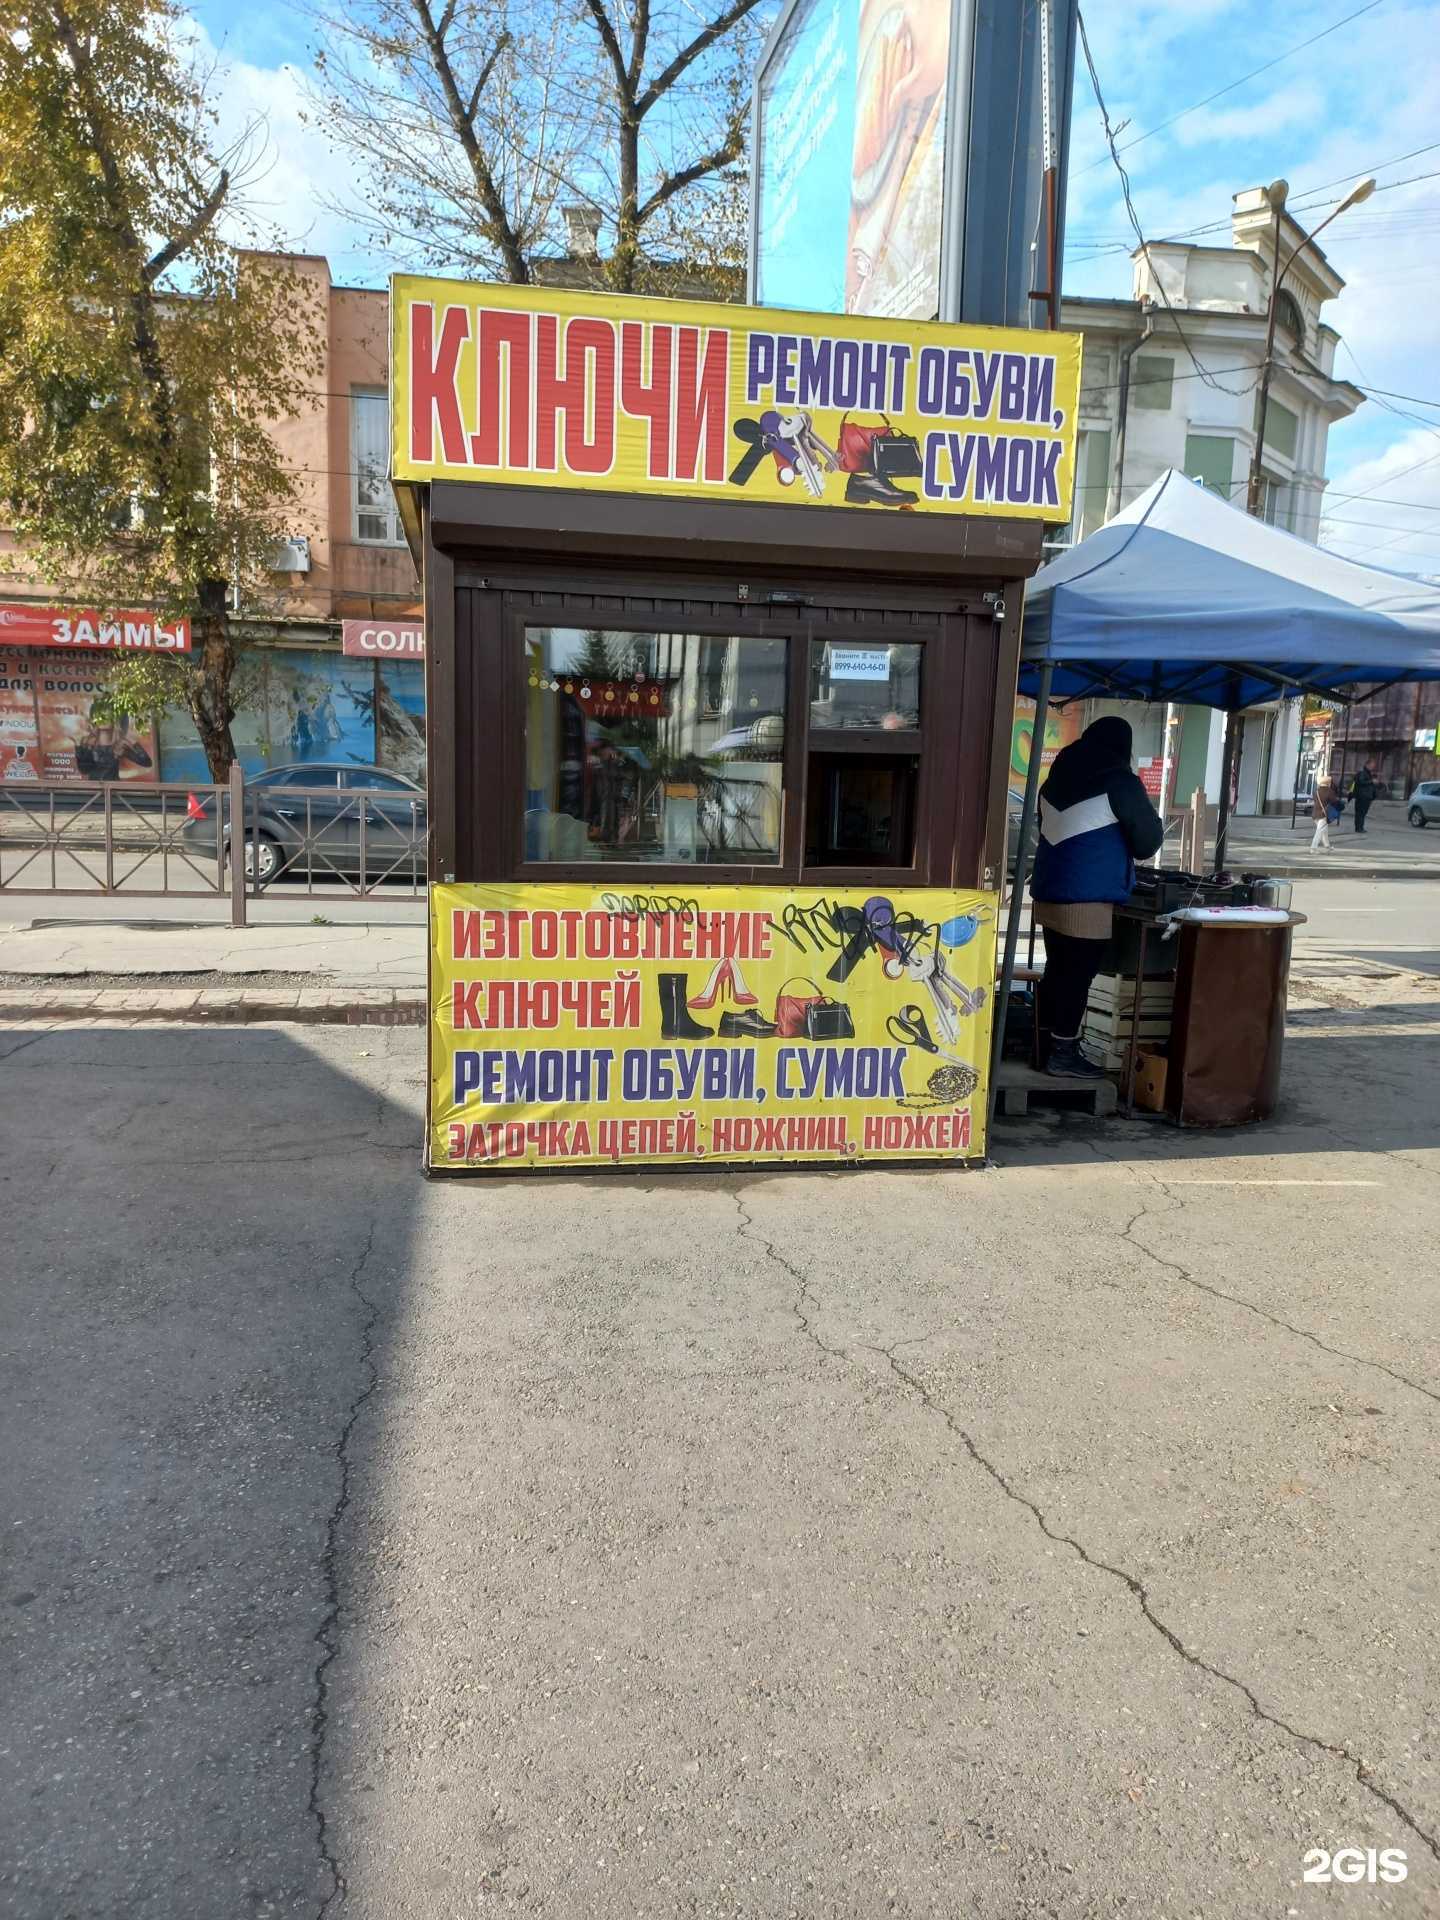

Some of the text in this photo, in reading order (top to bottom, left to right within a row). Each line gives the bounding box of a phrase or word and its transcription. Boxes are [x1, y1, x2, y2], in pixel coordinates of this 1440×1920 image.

[410, 303, 728, 483] КЛЮЧИ
[748, 333, 1063, 429] РЕМОНТ ОБУВИ,
[924, 431, 1062, 506] СУМОК
[52, 612, 185, 649] ЗАЙМЫ
[452, 910, 772, 960] ИЗГОТОВЛЕНИЕ
[452, 971, 640, 1030] КЛЮЧЕЙ
[454, 1047, 908, 1104] РЕМОНТ ОБУВИ, СУМОК
[448, 1108, 969, 1161] ЗАТОЧКА ЦЕПЕЙ, НОЖНИЦ, НОЖЕЙ
